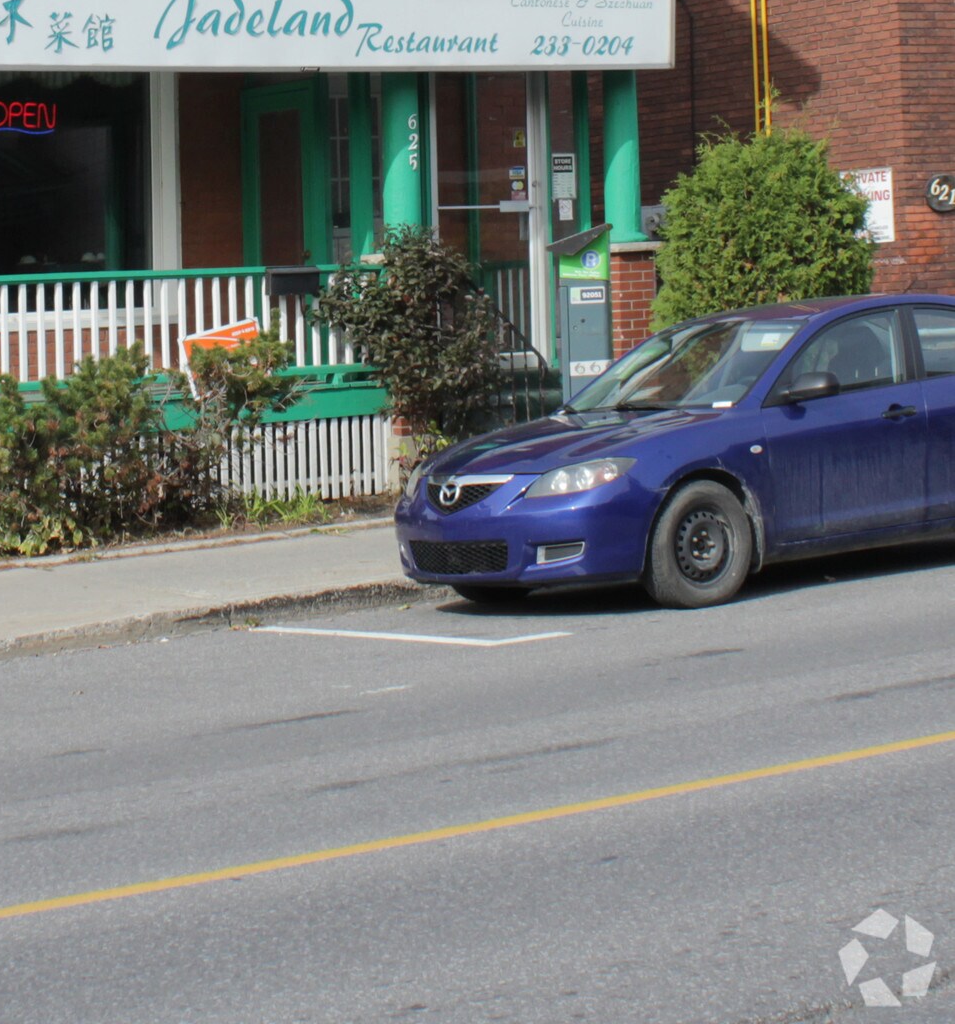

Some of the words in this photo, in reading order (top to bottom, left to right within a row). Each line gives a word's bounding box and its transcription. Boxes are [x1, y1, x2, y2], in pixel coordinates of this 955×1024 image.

[561, 10, 604, 28] Cuisine
[355, 22, 499, 57] Restaurant
[530, 34, 635, 57] 233-0204
[407, 113, 419, 171] 625
[930, 178, 955, 205] 621
